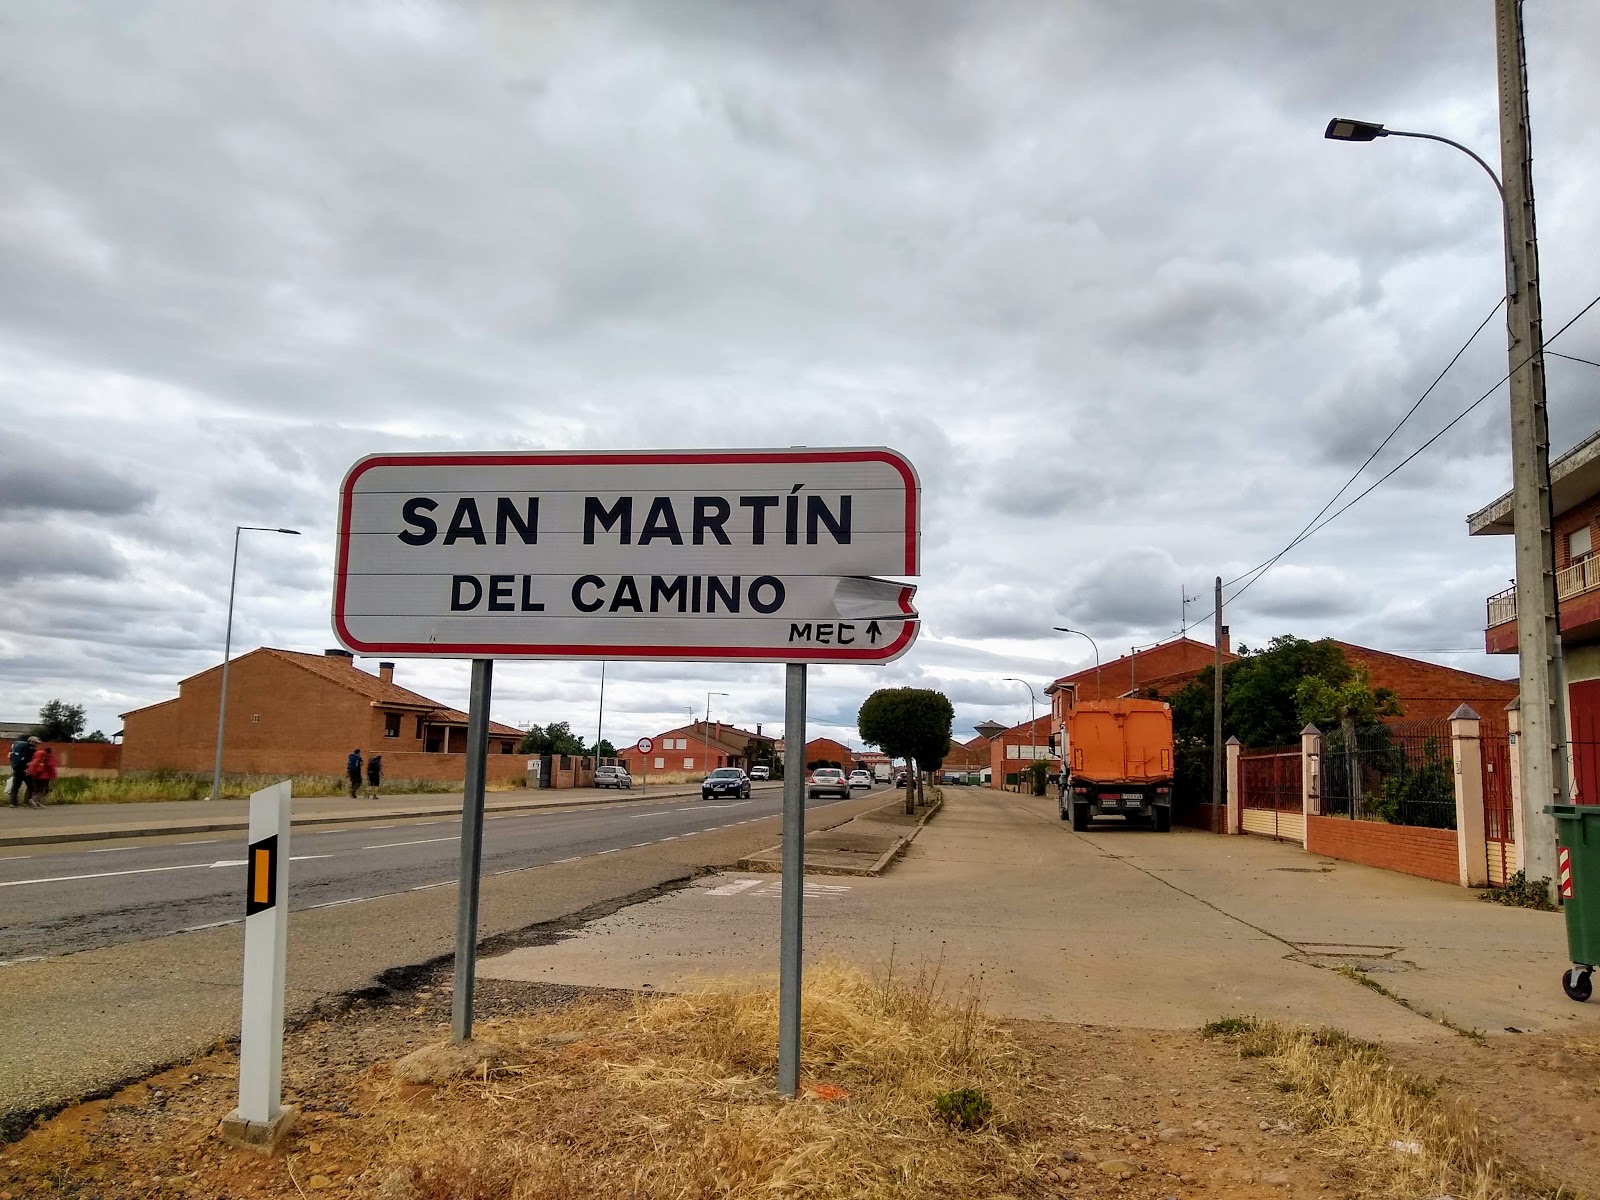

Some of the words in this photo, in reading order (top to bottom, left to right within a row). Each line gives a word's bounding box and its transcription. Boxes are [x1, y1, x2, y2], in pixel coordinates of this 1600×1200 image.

[398, 496, 540, 546] SAN
[583, 484, 853, 545] MARTÍN
[450, 575, 545, 612] DEL
[572, 574, 786, 614] CAMINO
[789, 622, 855, 645] MEC
